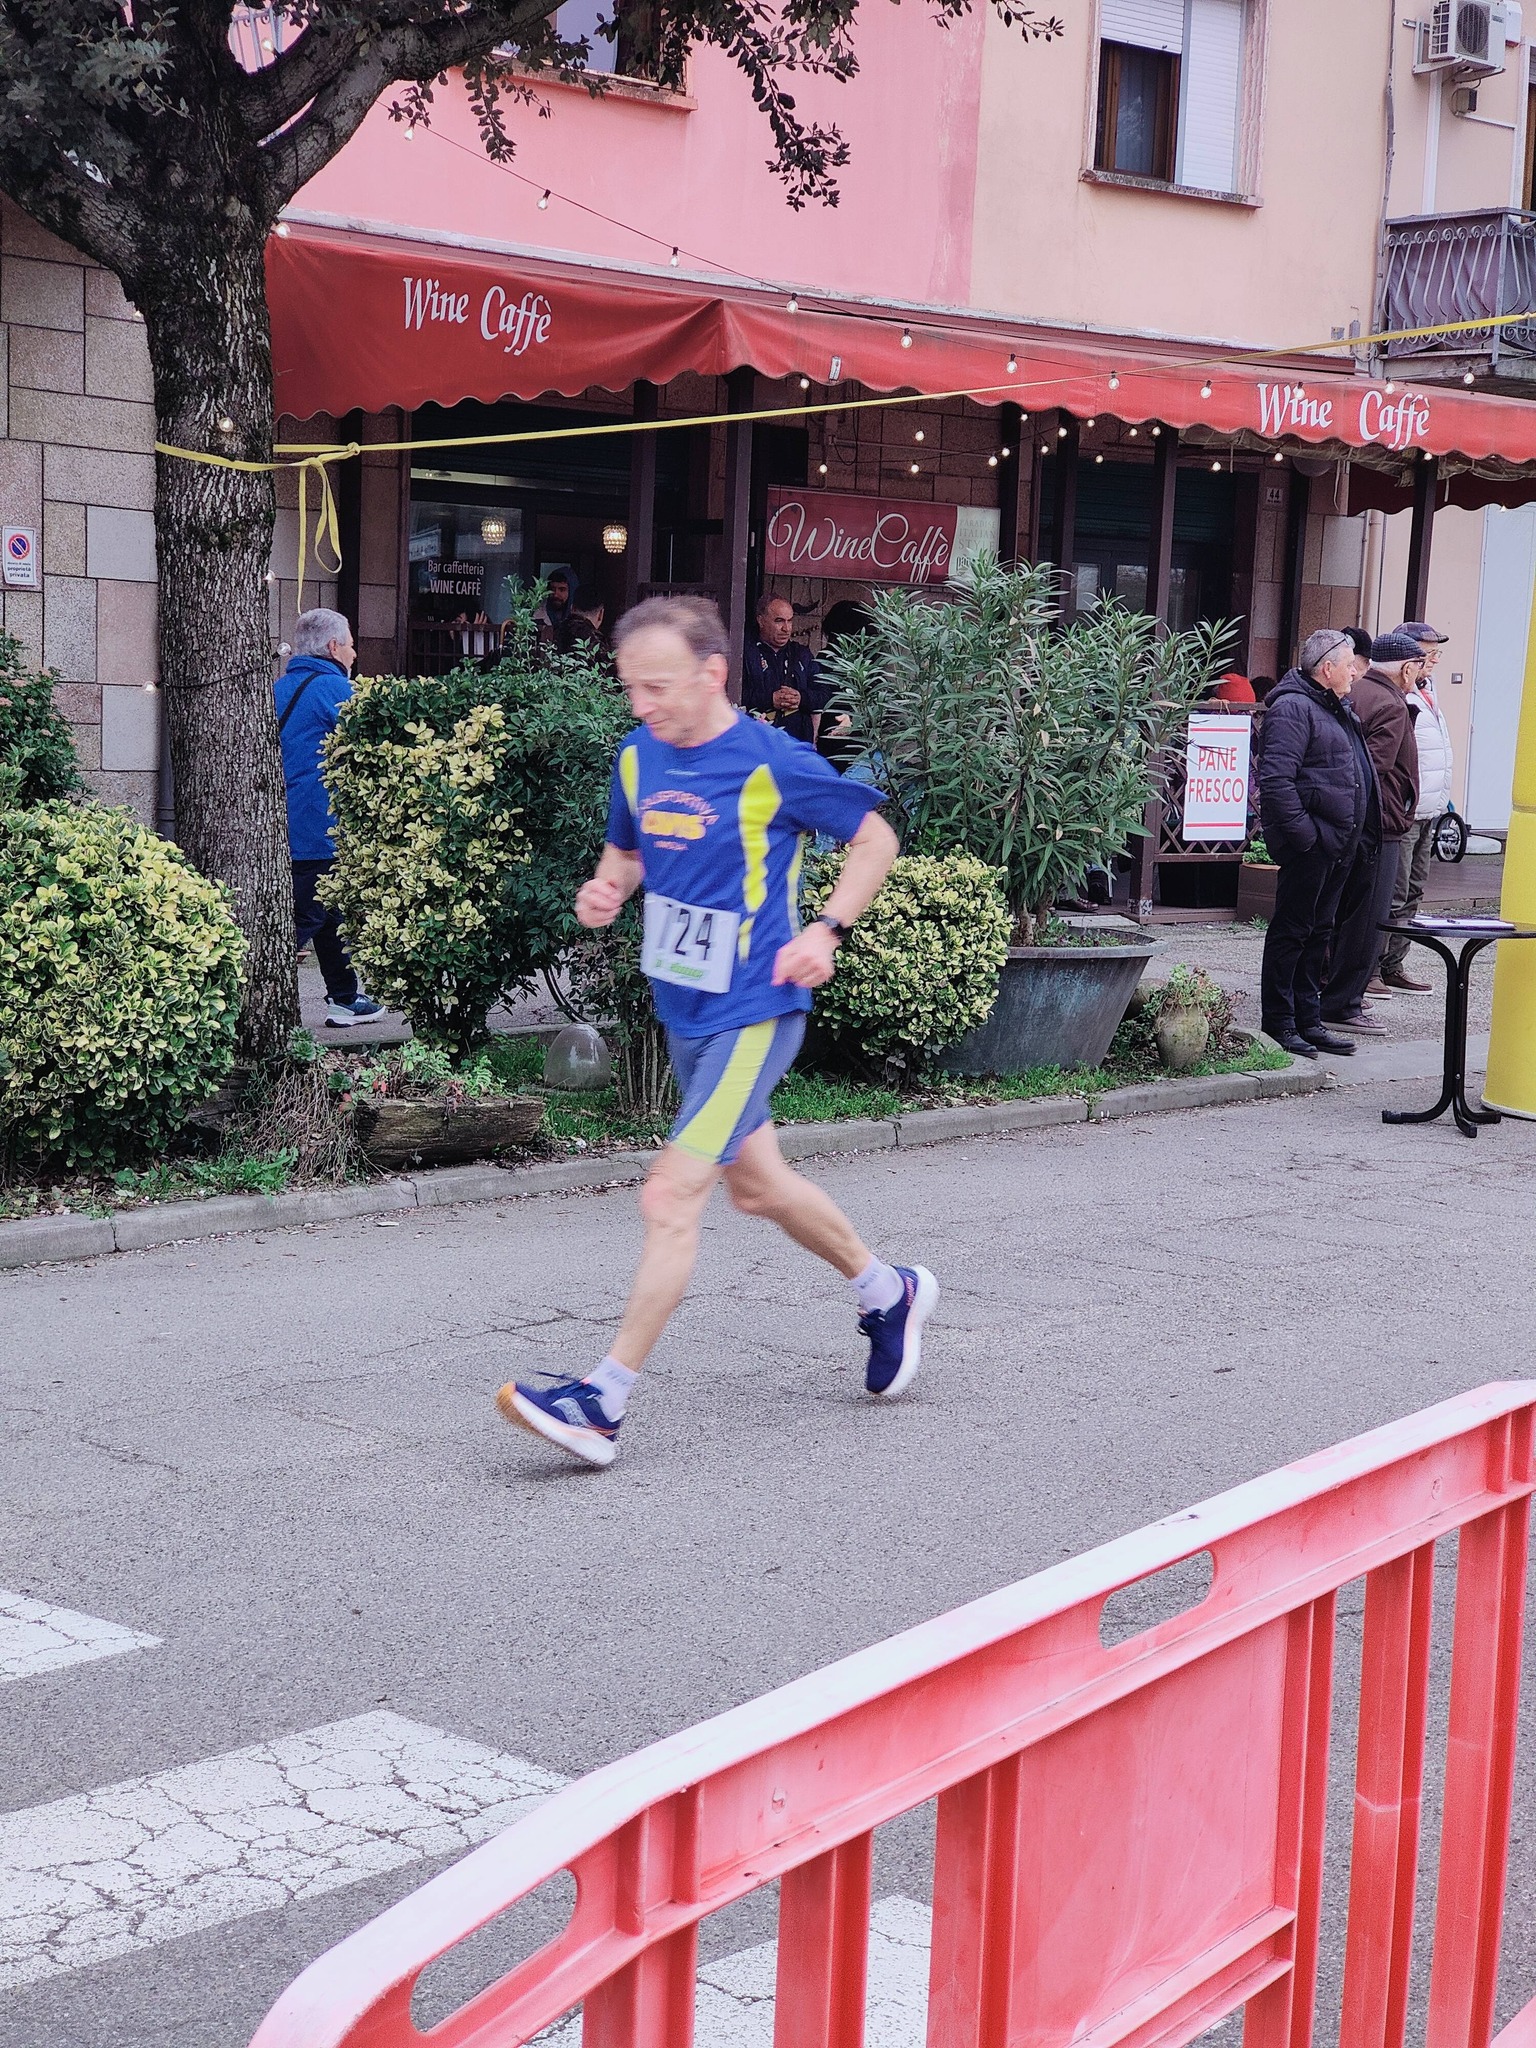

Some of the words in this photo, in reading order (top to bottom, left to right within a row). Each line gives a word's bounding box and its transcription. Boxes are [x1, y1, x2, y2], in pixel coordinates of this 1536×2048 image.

[402, 277, 469, 331] Wine
[480, 285, 552, 356] Caffè
[1257, 383, 1334, 435] Wine
[1359, 390, 1431, 450] Caffè
[959, 528, 996, 539] ITALIAN
[958, 539, 995, 552] STYLE
[428, 560, 441, 572] Bar
[443, 561, 484, 575] caffetteria
[430, 580, 454, 595] WINE
[455, 578, 482, 596] CAFFÈ
[1198, 747, 1238, 771] PANE
[1188, 777, 1244, 803] FRESCO
